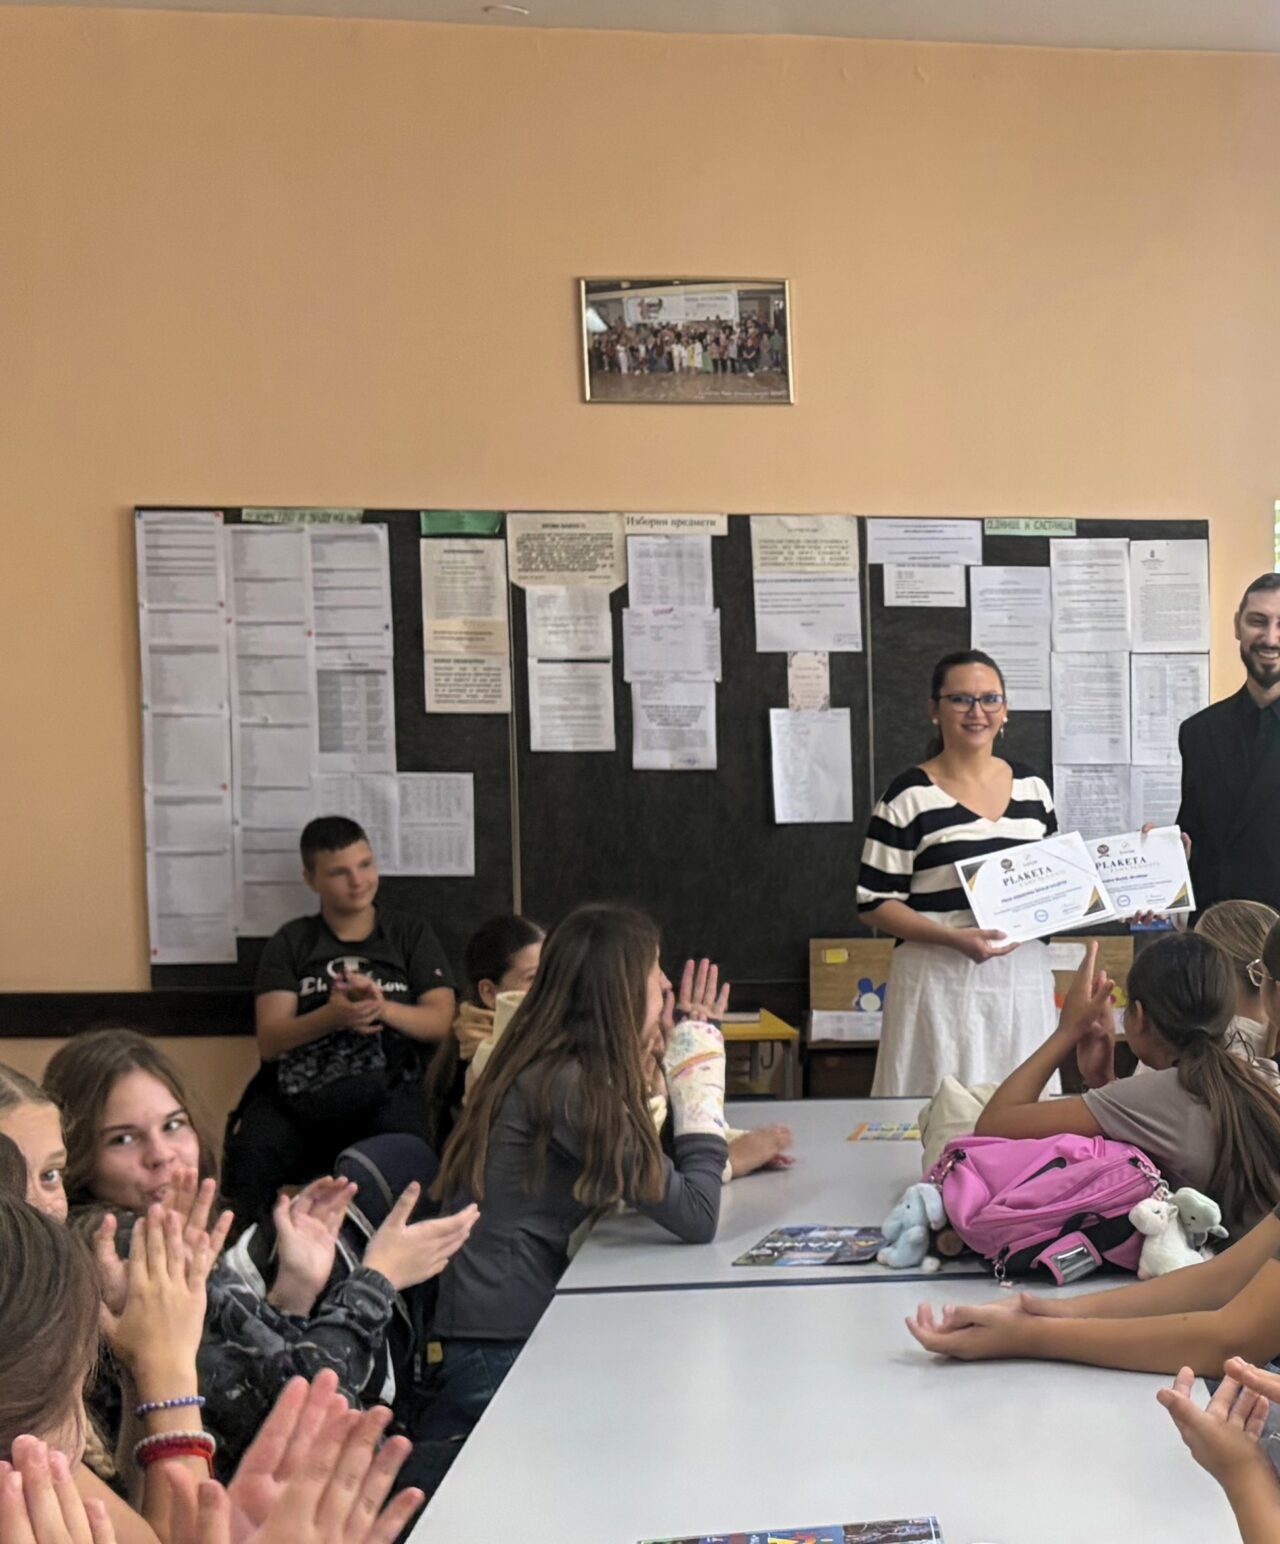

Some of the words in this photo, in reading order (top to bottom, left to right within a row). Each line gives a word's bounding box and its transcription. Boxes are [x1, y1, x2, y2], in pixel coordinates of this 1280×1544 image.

[626, 516, 668, 529] Изборни
[671, 517, 717, 529] предмети
[1095, 856, 1147, 871] PLAKETA
[1002, 866, 1053, 887] PLAKETA
